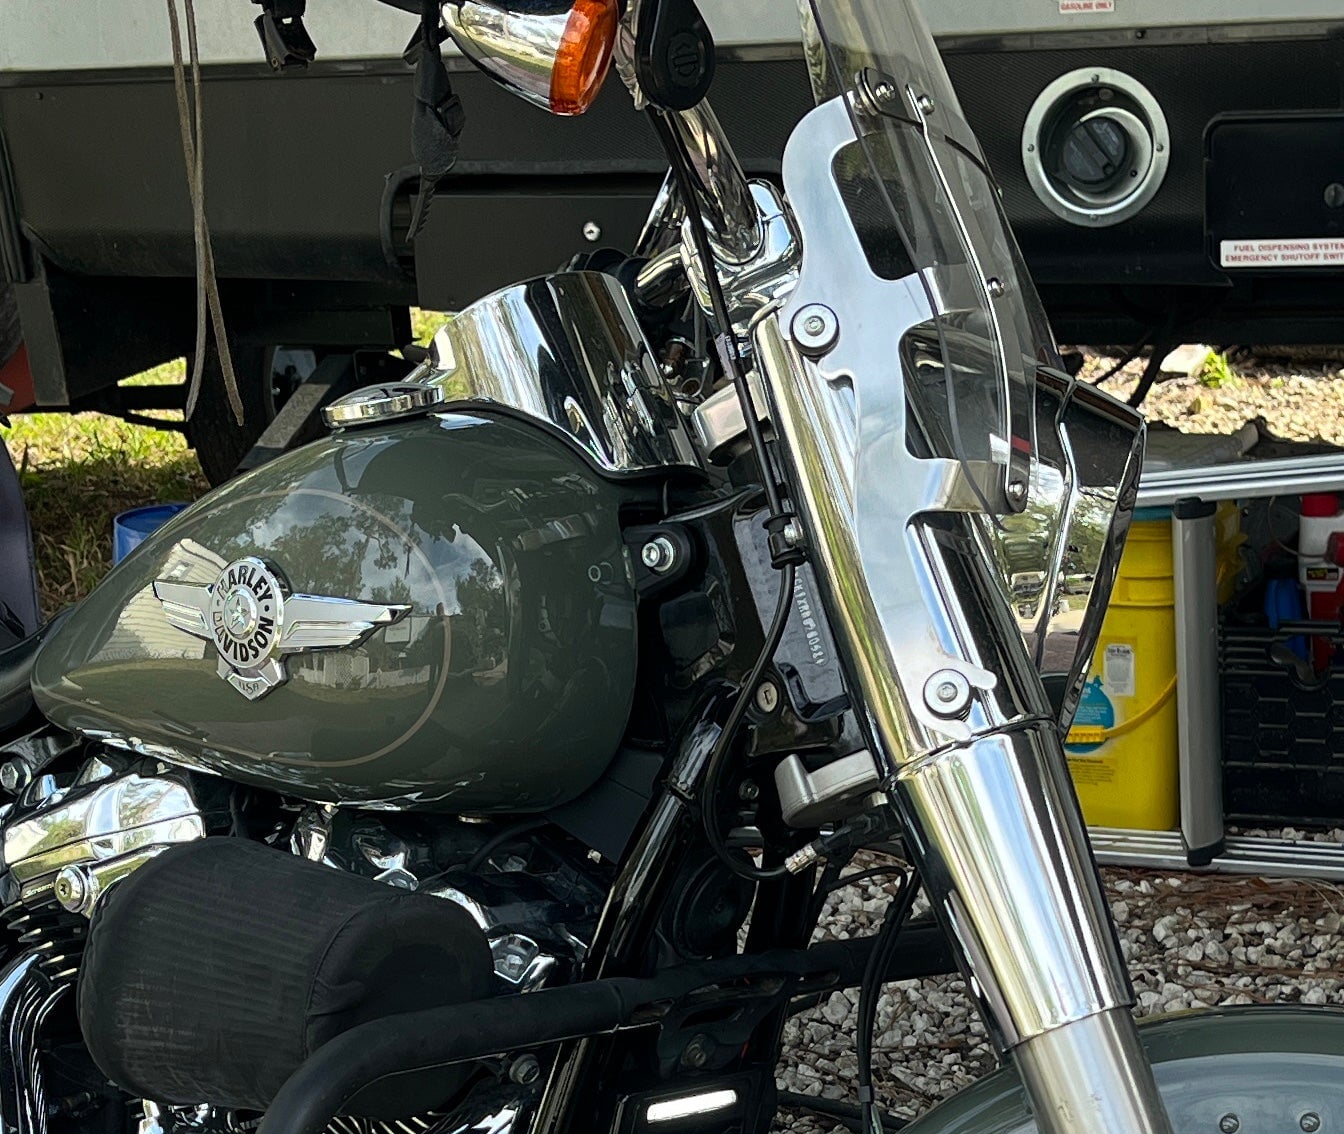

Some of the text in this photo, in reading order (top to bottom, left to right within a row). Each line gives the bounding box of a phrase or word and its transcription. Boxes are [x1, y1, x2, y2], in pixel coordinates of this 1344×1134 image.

[1234, 244, 1256, 252] FUEL
[1258, 243, 1310, 252] DISPENSING
[1225, 253, 1278, 262] EMERGENCY
[1281, 252, 1320, 262] SHUTOFF
[216, 565, 273, 602] HARLEY
[212, 611, 274, 662] DAVIDSON
[238, 680, 260, 692] USA
